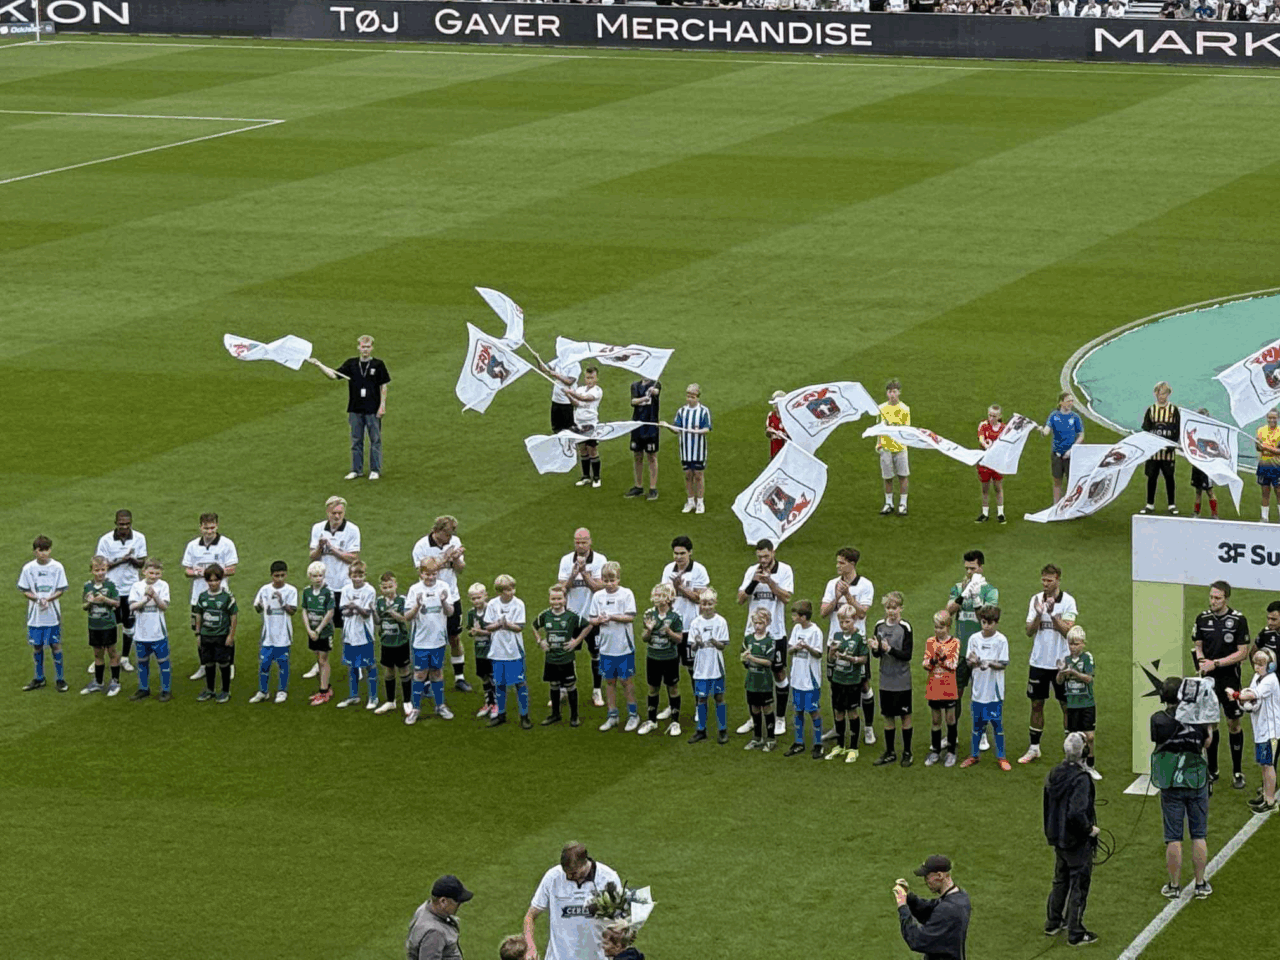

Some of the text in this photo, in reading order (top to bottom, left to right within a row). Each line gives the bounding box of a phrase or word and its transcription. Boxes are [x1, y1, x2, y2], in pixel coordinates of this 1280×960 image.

[46, 0, 130, 25] ON
[329, 6, 873, 46] TØJ GAVER MERCHANDISE
[1217, 541, 1247, 564] 3F
